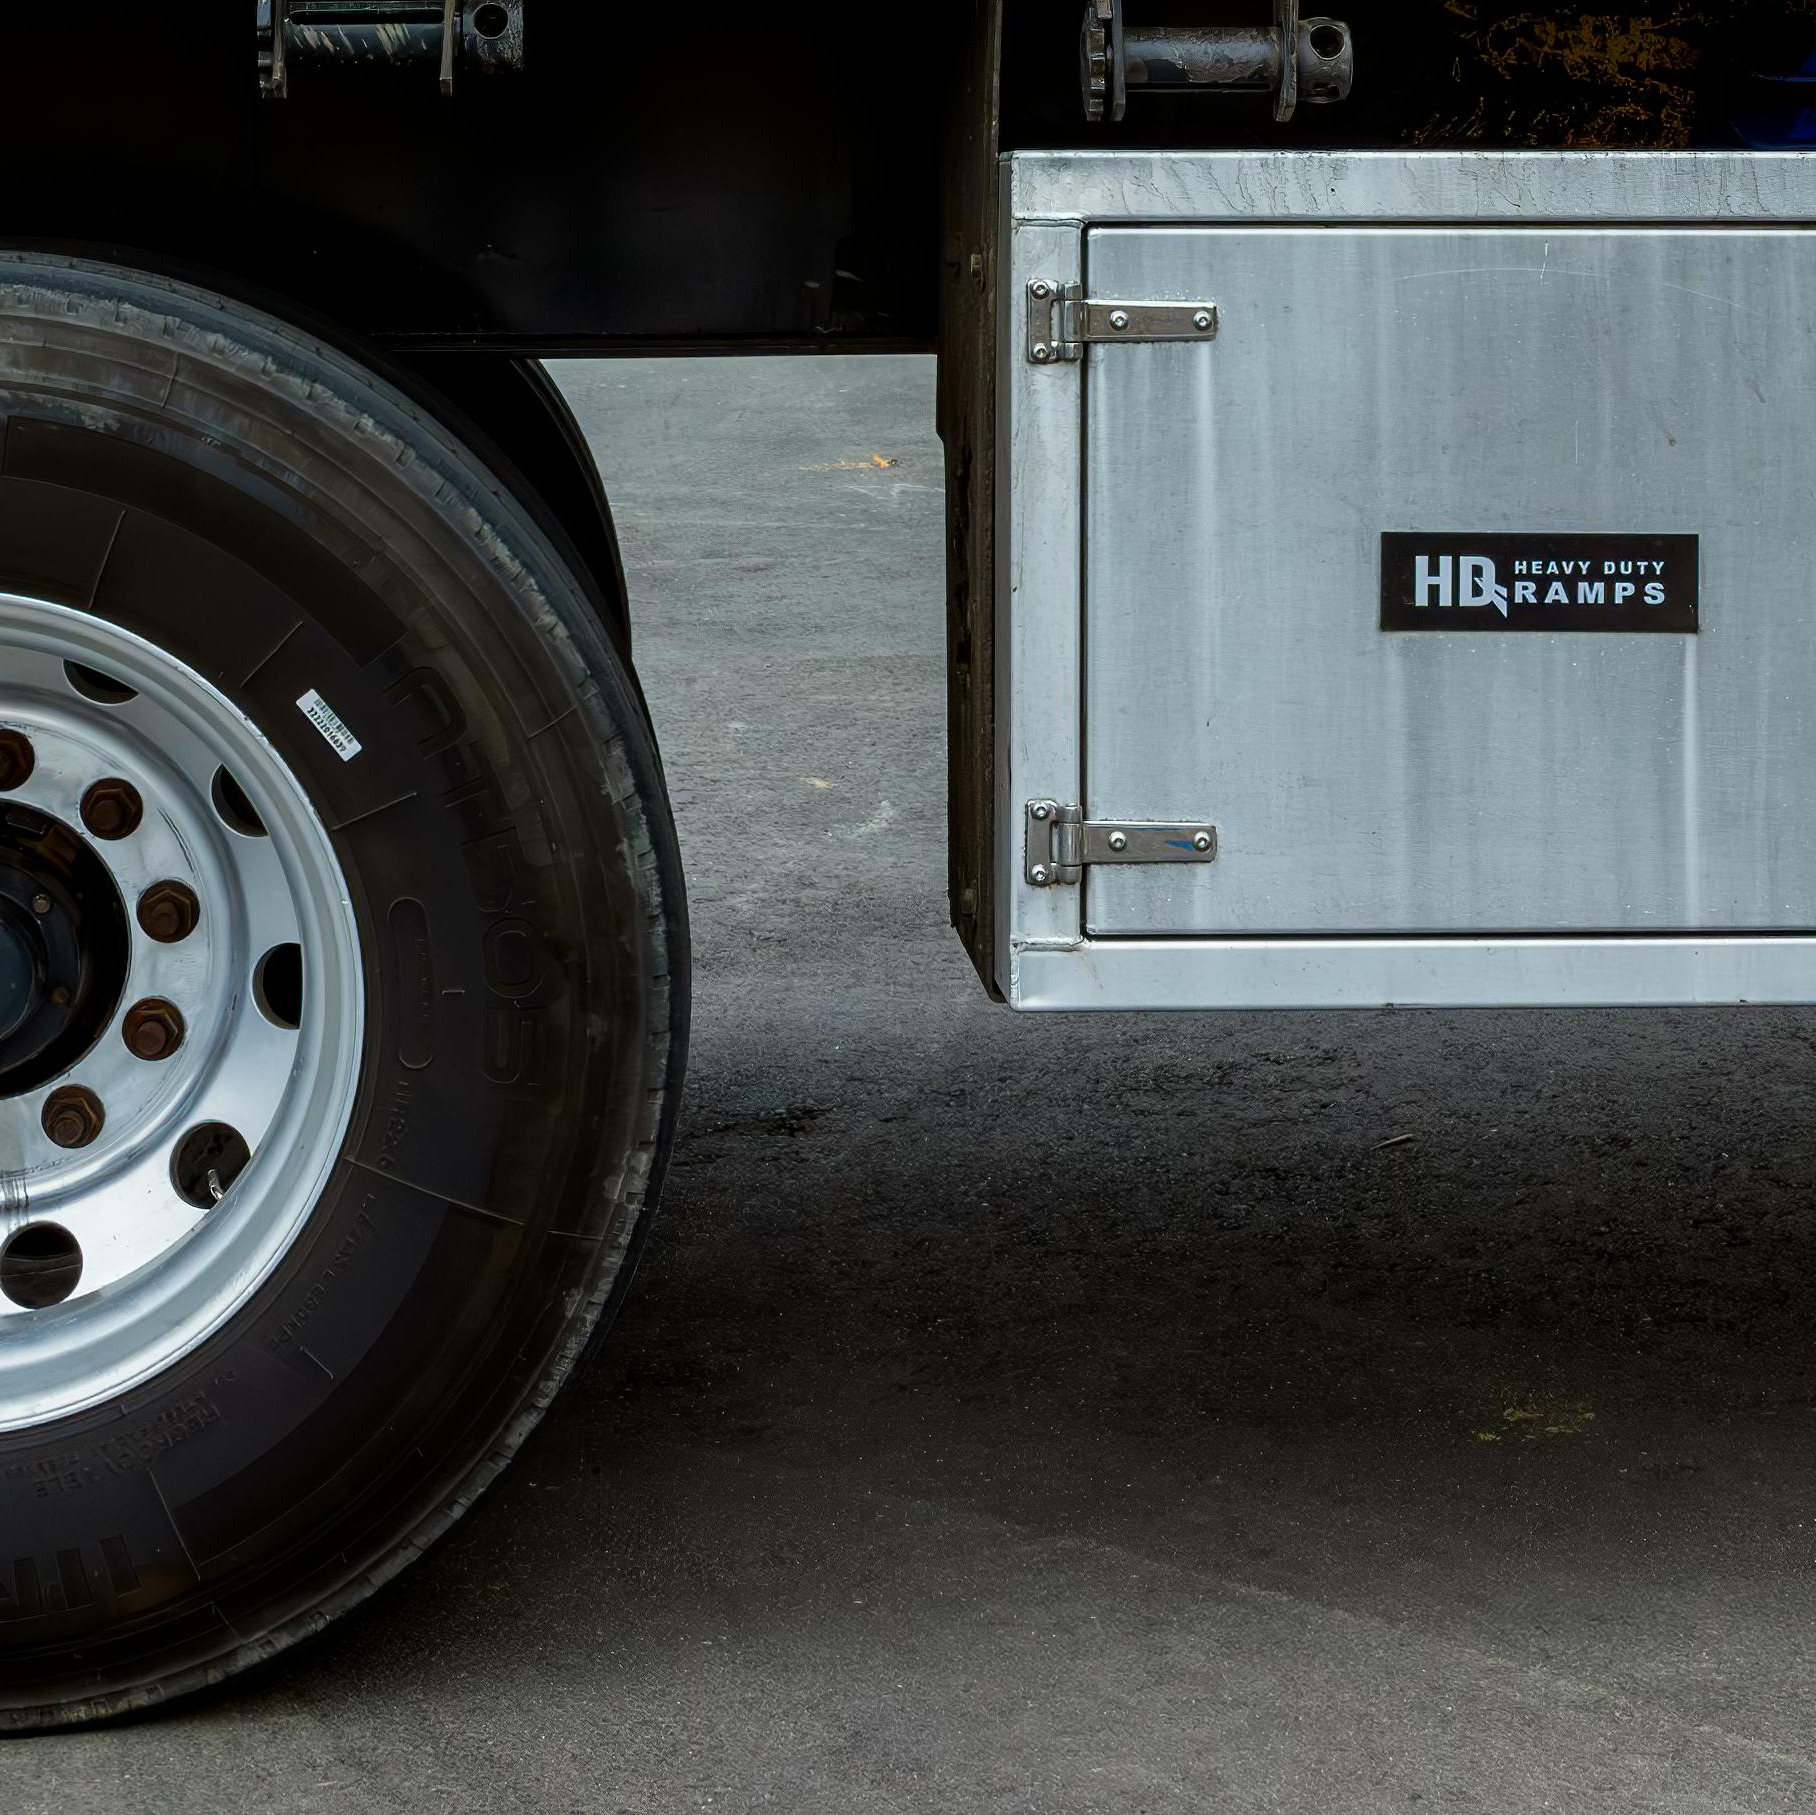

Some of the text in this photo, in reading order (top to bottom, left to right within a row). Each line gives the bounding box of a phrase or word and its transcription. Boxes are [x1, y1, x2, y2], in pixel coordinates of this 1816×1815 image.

[1514, 560, 1666, 575] HEAVY DUTY
[1514, 581, 1666, 605] RAMPS
